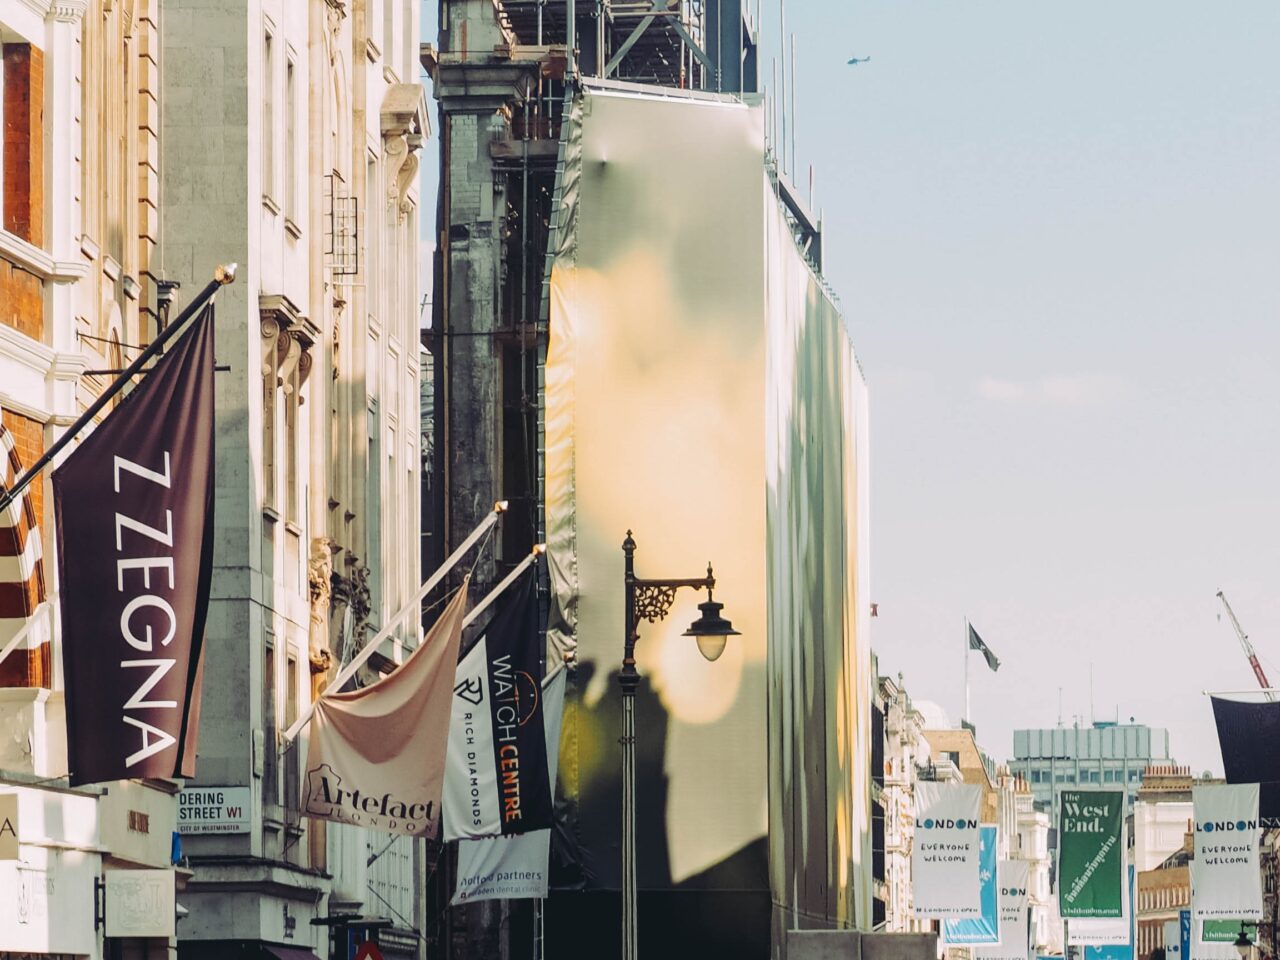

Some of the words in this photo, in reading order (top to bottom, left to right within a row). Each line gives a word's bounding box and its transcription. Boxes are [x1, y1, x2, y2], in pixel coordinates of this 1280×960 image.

[464, 712, 475, 745] RICH
[467, 752, 482, 826] DIAMONDS
[179, 792, 224, 805] DERING
[313, 776, 435, 822] Artefact
[1065, 793, 1080, 801] the
[179, 806, 222, 820] STREET
[226, 806, 242, 819] W1
[1064, 802, 1109, 817] West
[337, 808, 433, 833] LONDON
[916, 818, 978, 830] LONDON
[1064, 818, 1104, 833] End.
[1196, 820, 1257, 833] LONDON
[180, 825, 192, 833] CITY
[920, 843, 970, 851] EVERYONE
[1201, 844, 1252, 854] EVERYONE
[1205, 857, 1249, 865] WELCOME
[497, 871, 543, 883] partners
[1001, 888, 1026, 896] DON
